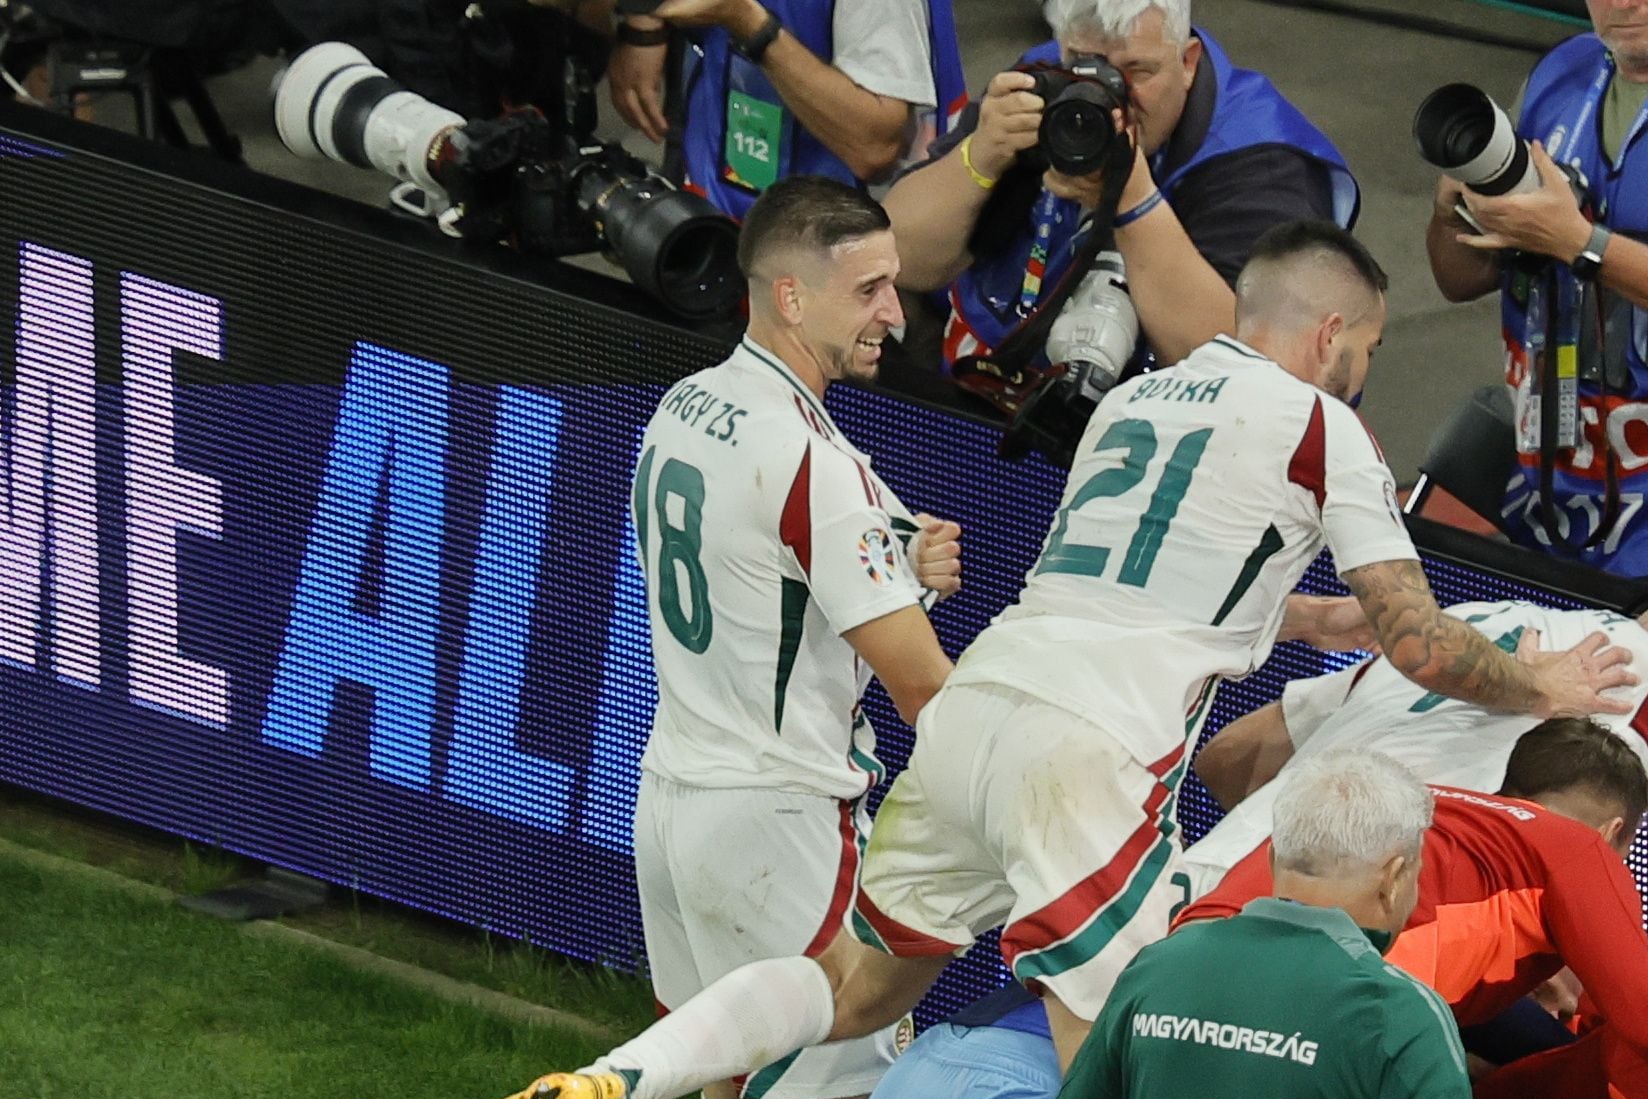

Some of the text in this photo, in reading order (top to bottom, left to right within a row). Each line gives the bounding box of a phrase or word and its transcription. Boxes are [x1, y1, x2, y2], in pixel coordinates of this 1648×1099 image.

[733, 131, 770, 162] 112
[1034, 418, 1214, 588] 21
[1132, 1012, 1319, 1066] MAGYARORSZÁG
